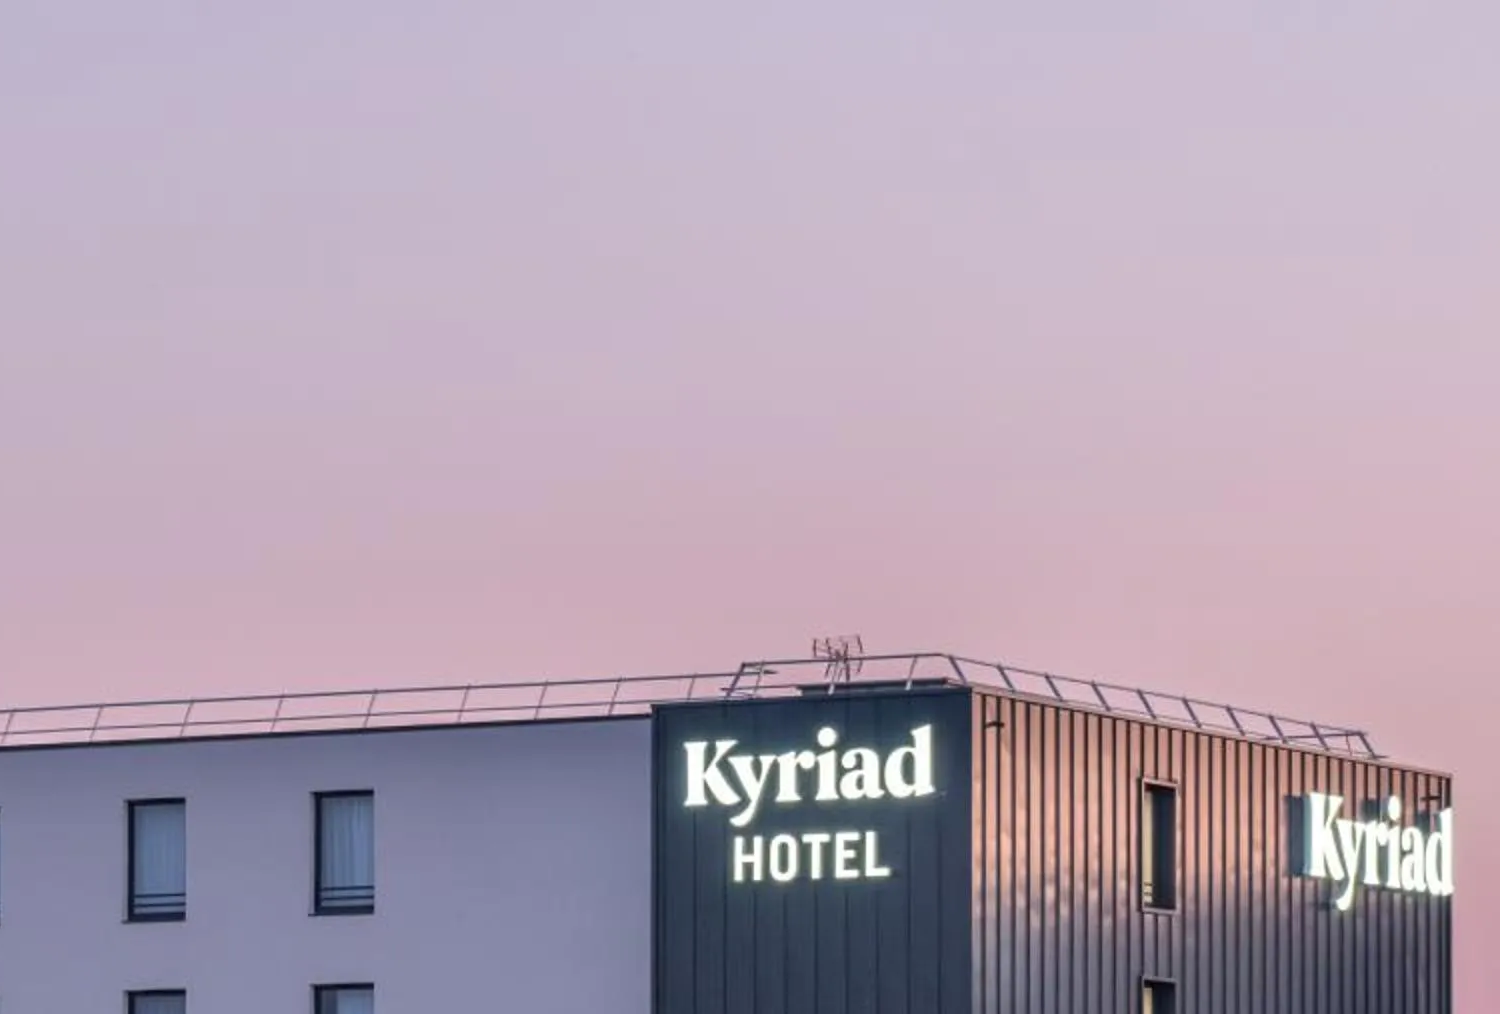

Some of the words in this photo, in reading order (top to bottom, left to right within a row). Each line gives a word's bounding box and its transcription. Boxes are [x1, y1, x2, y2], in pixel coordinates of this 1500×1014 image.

[683, 723, 936, 827] Kyriad
[734, 831, 892, 882] HOTEL
[1309, 791, 1454, 911] Kyriad
